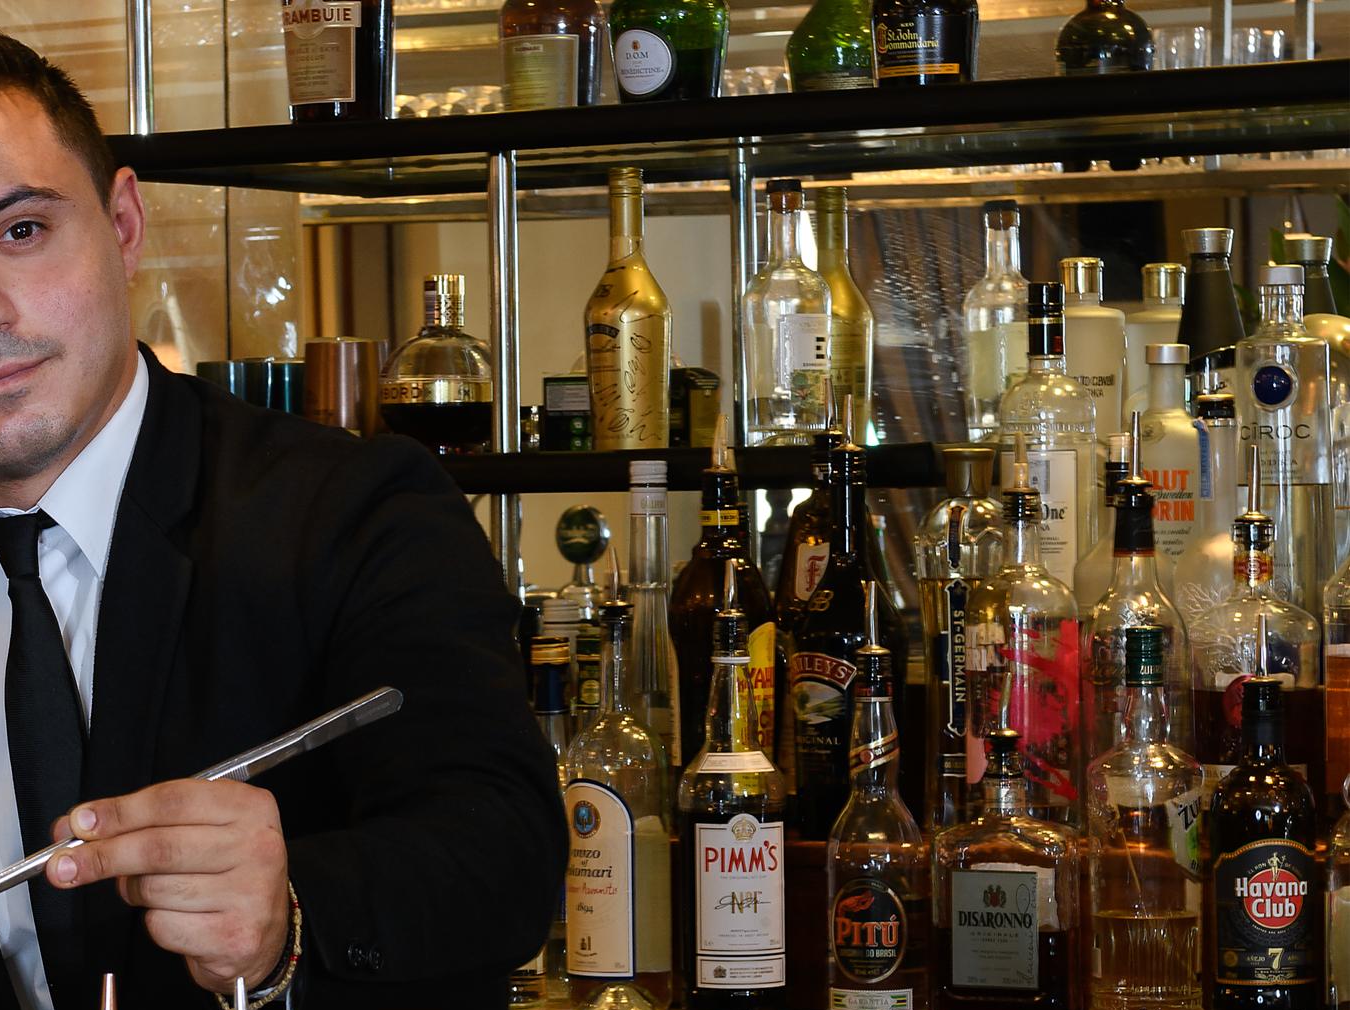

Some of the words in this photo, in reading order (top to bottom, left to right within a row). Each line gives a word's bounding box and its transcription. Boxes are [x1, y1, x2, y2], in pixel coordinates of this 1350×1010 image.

[953, 609, 967, 703] ST-GERMAIN
[705, 840, 778, 873] PIMM'S
[1235, 877, 1308, 897] Havana
[1251, 899, 1296, 918] Club
[836, 914, 899, 947] PITÚ
[957, 911, 1033, 929] DISARONNO
[876, 948, 897, 958] BRASIL
[1268, 947, 1284, 970] 7
